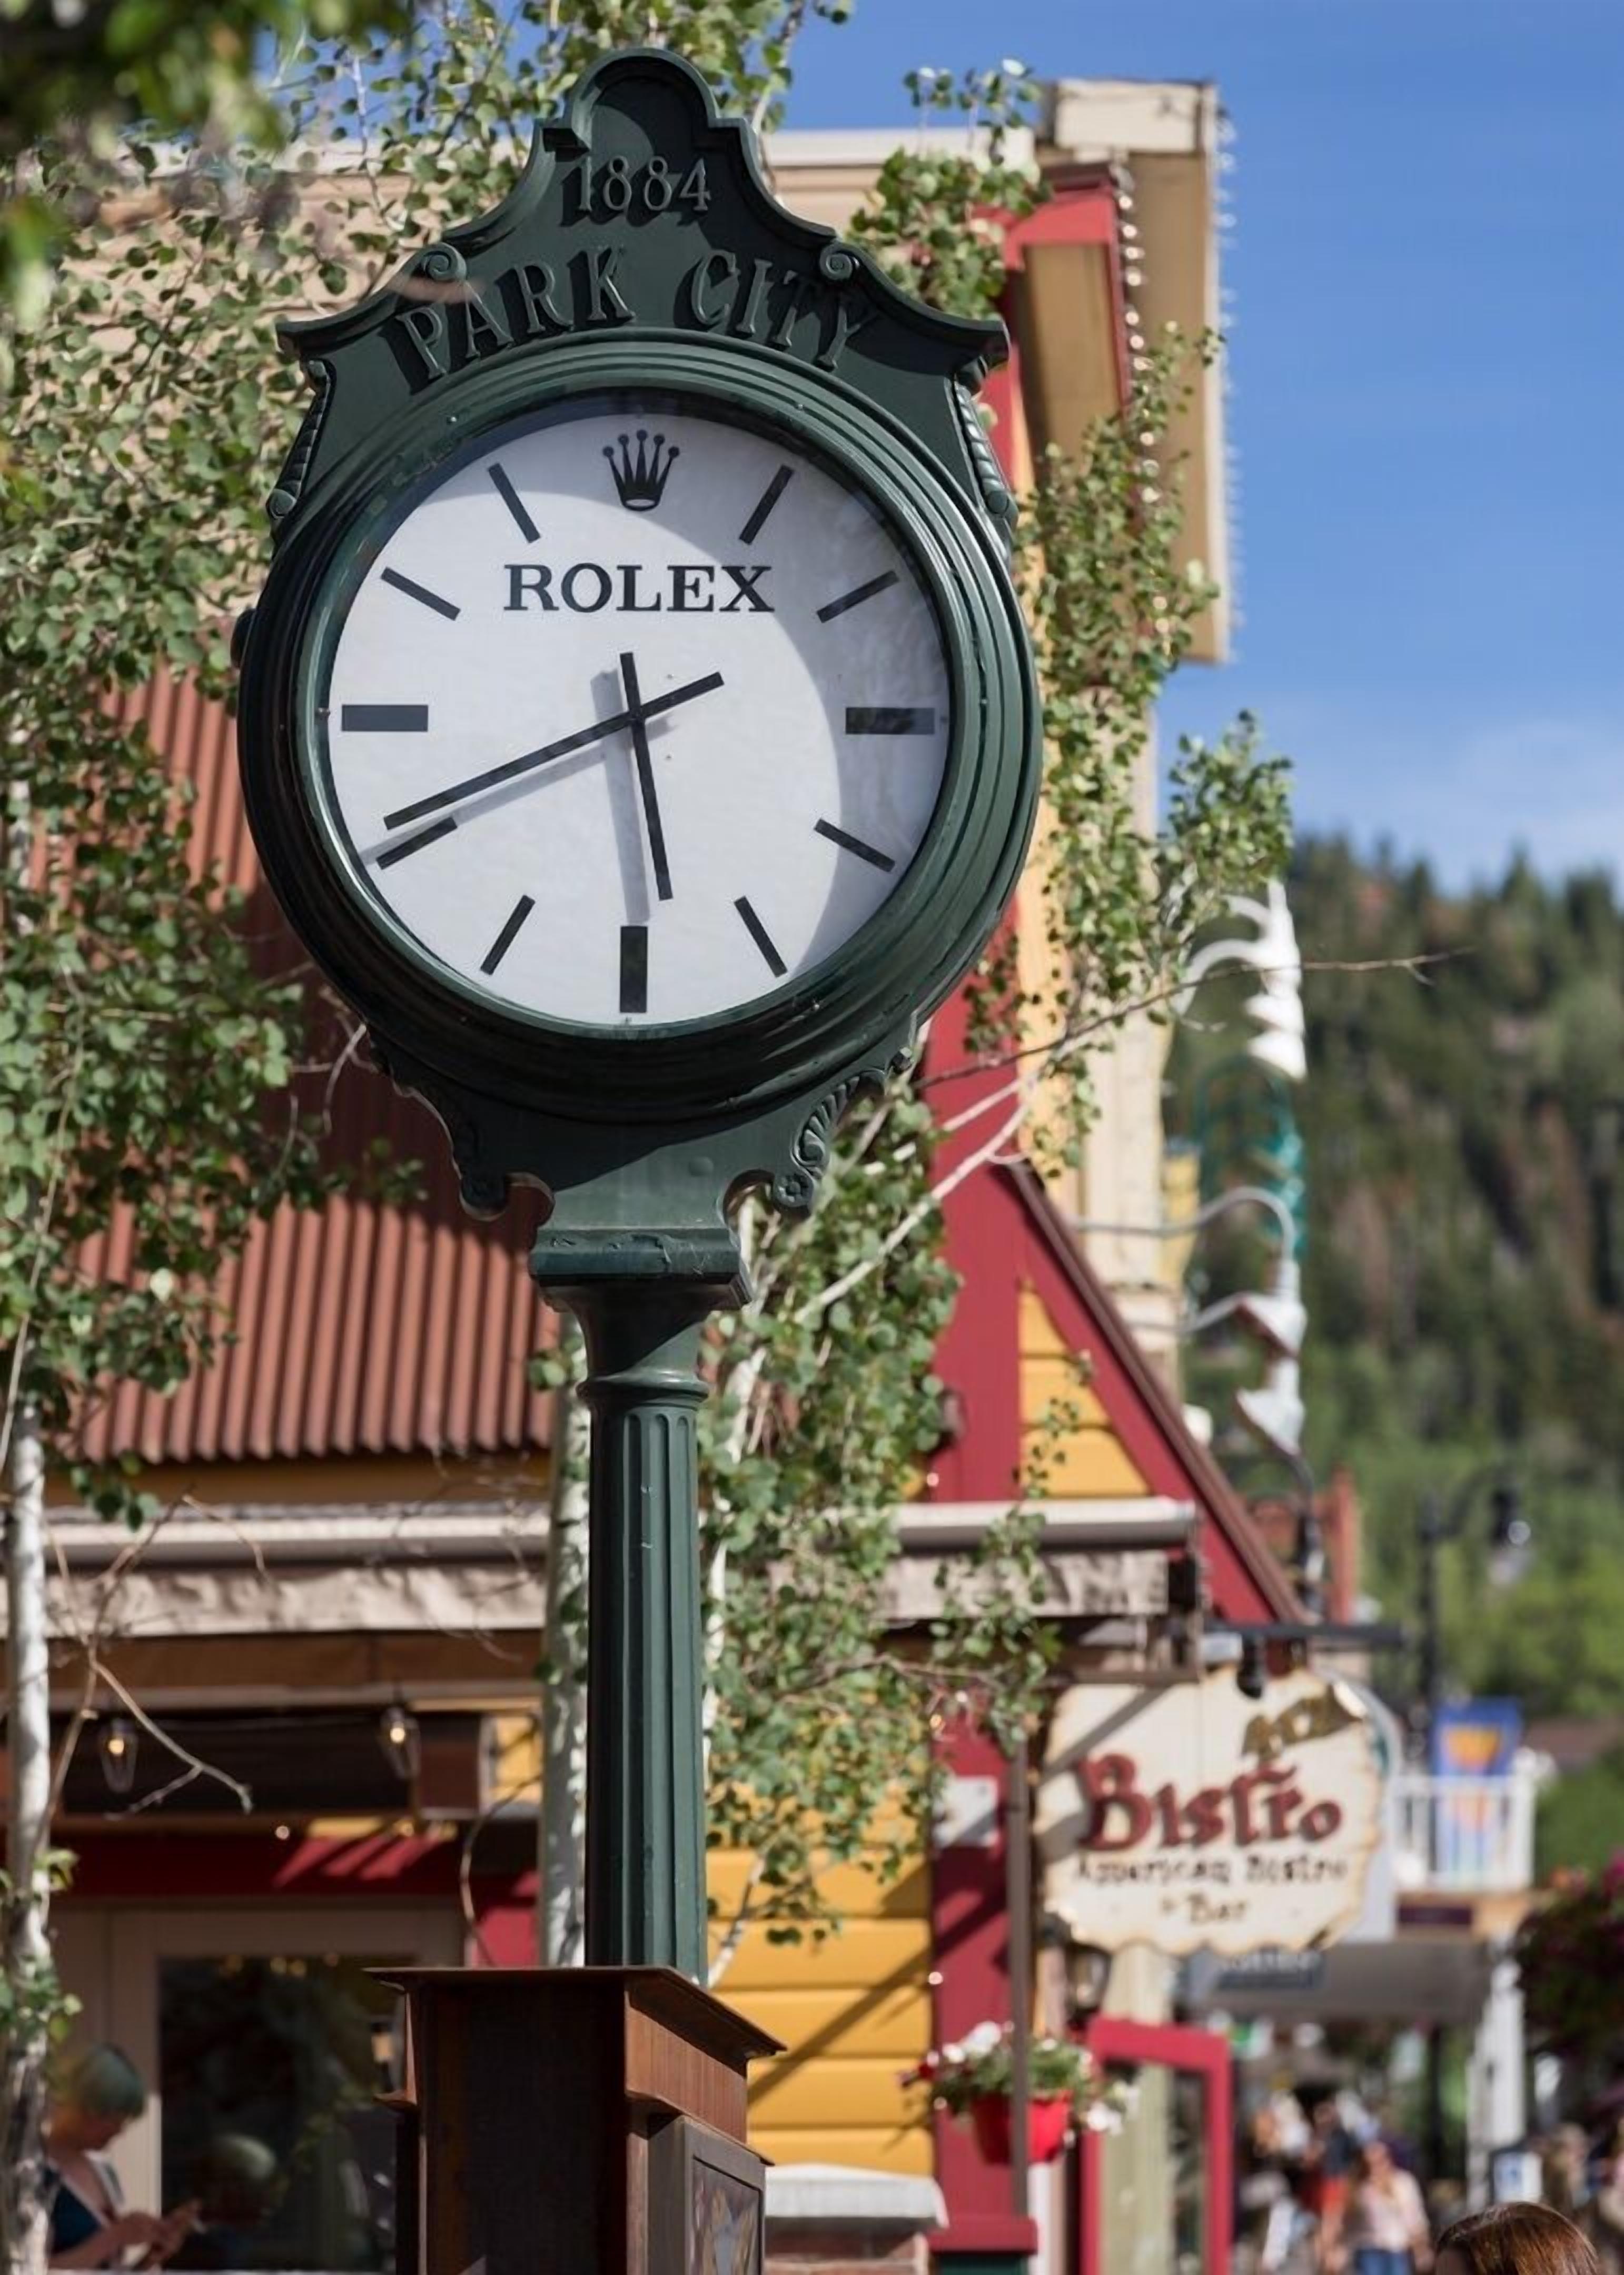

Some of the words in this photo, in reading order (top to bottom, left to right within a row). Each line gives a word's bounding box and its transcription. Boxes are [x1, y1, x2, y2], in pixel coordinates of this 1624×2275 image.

[574, 155, 711, 212] 1884
[395, 243, 637, 381] PARK
[690, 249, 877, 372] CITY
[503, 562, 775, 614] ROLEX
[1075, 1753, 1343, 1853] Bistro
